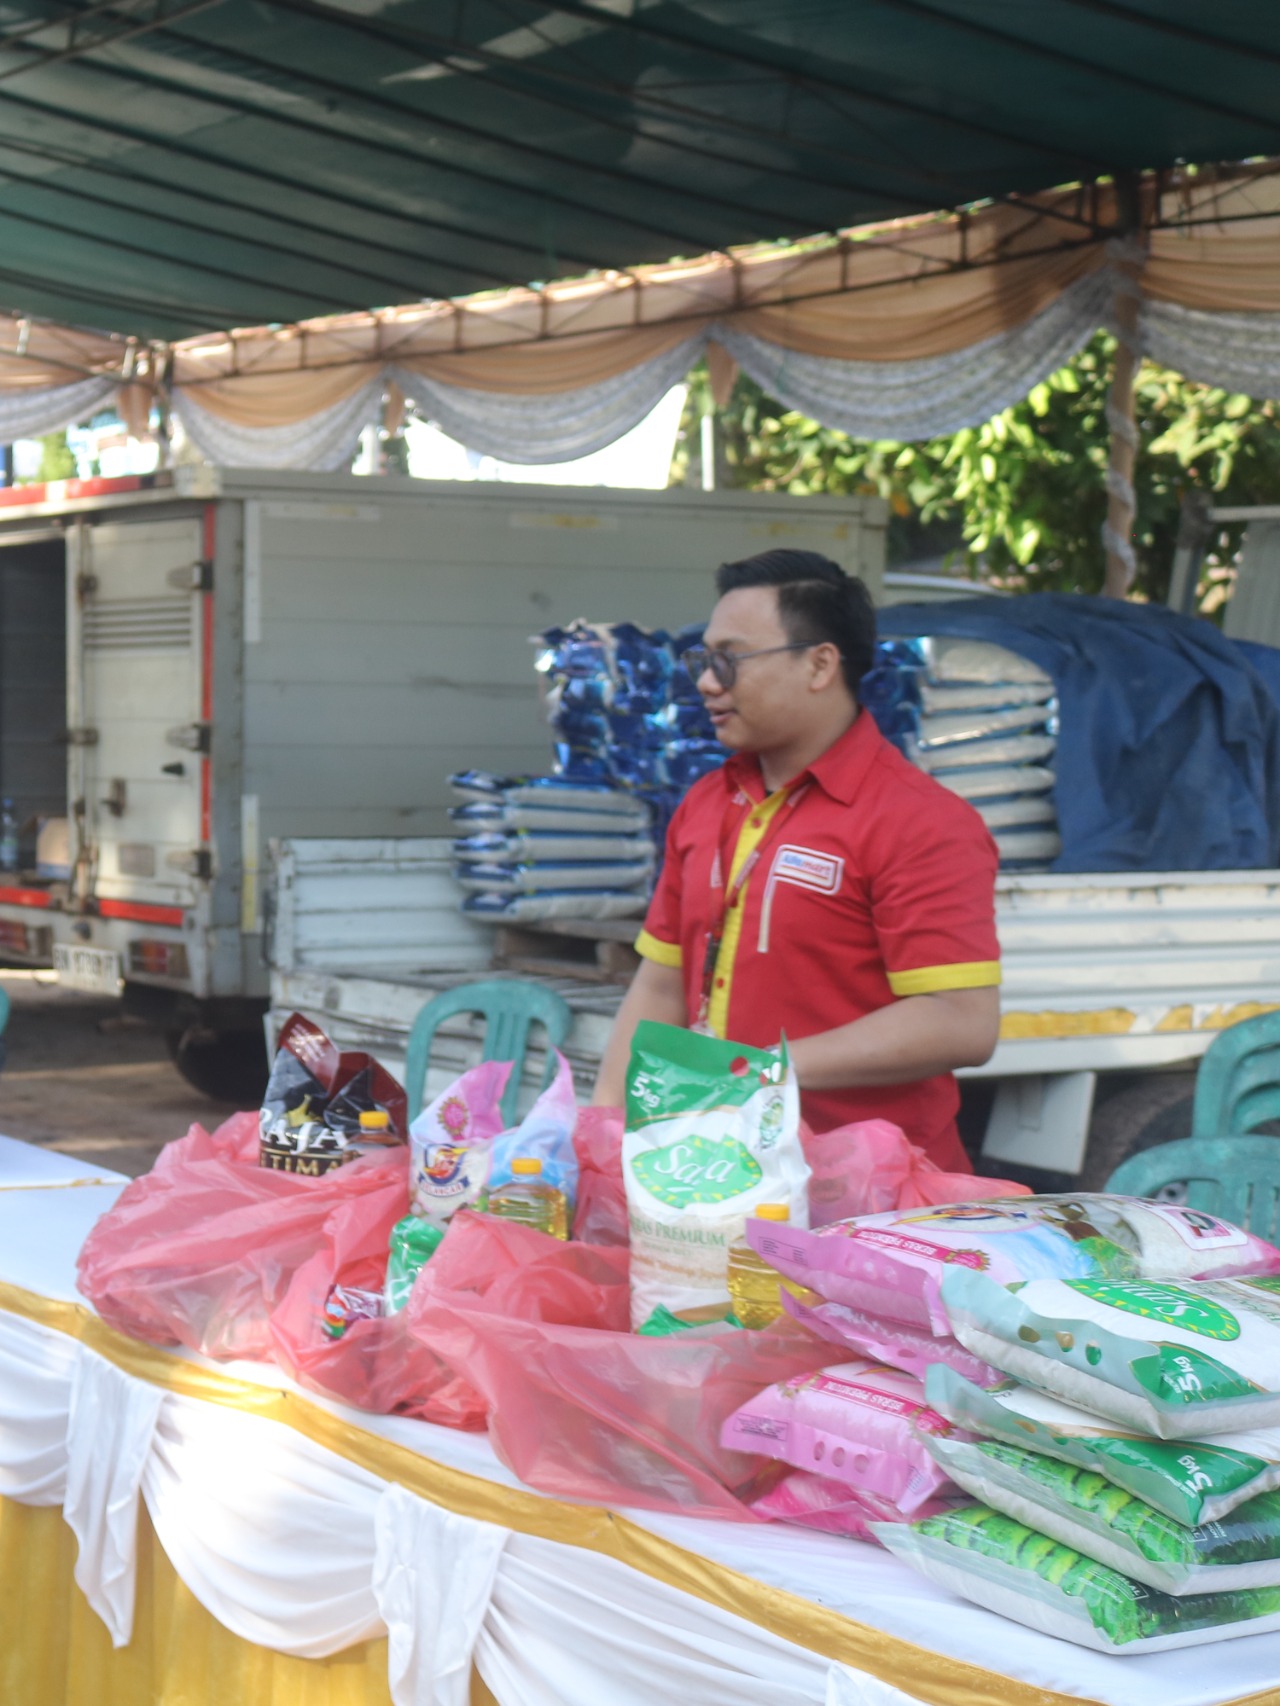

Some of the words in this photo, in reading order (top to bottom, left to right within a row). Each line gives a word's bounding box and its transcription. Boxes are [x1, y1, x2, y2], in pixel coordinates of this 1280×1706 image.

[654, 1221, 726, 1247] PREMIUM
[823, 1381, 872, 1402] PREMIUM
[869, 1393, 906, 1411] BERAS
